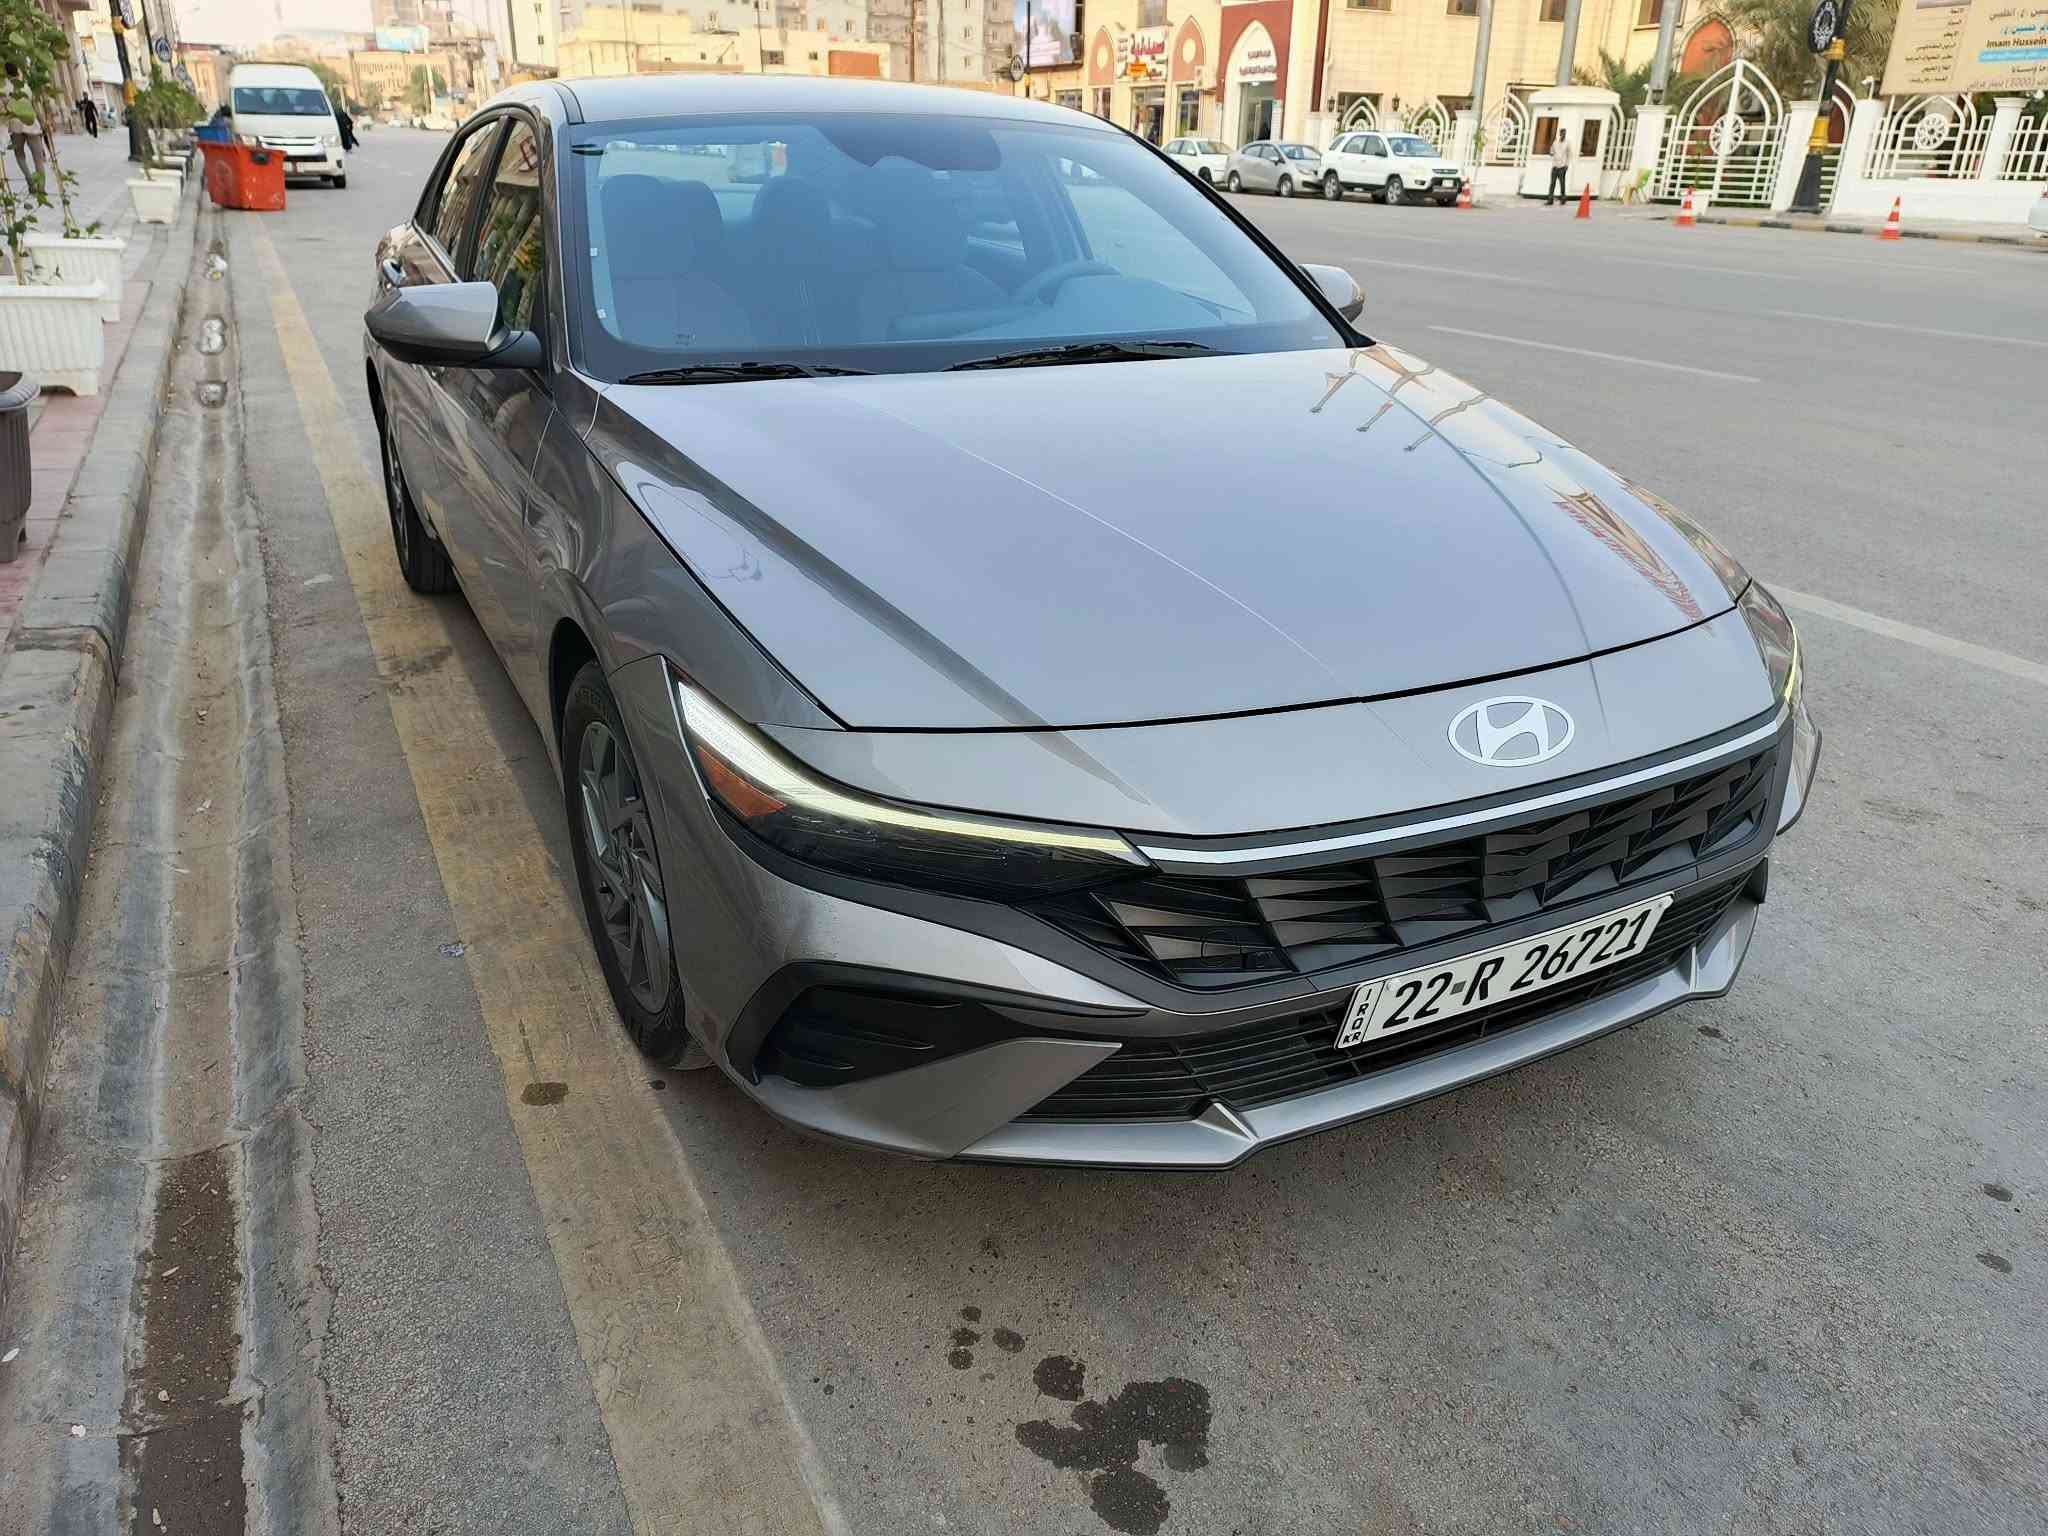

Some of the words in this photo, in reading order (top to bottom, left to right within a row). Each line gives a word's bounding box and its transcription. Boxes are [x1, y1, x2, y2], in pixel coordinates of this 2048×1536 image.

[1986, 39, 2011, 48] Imam
[2012, 36, 2047, 48] Hussein
[1510, 909, 1652, 992] 26721
